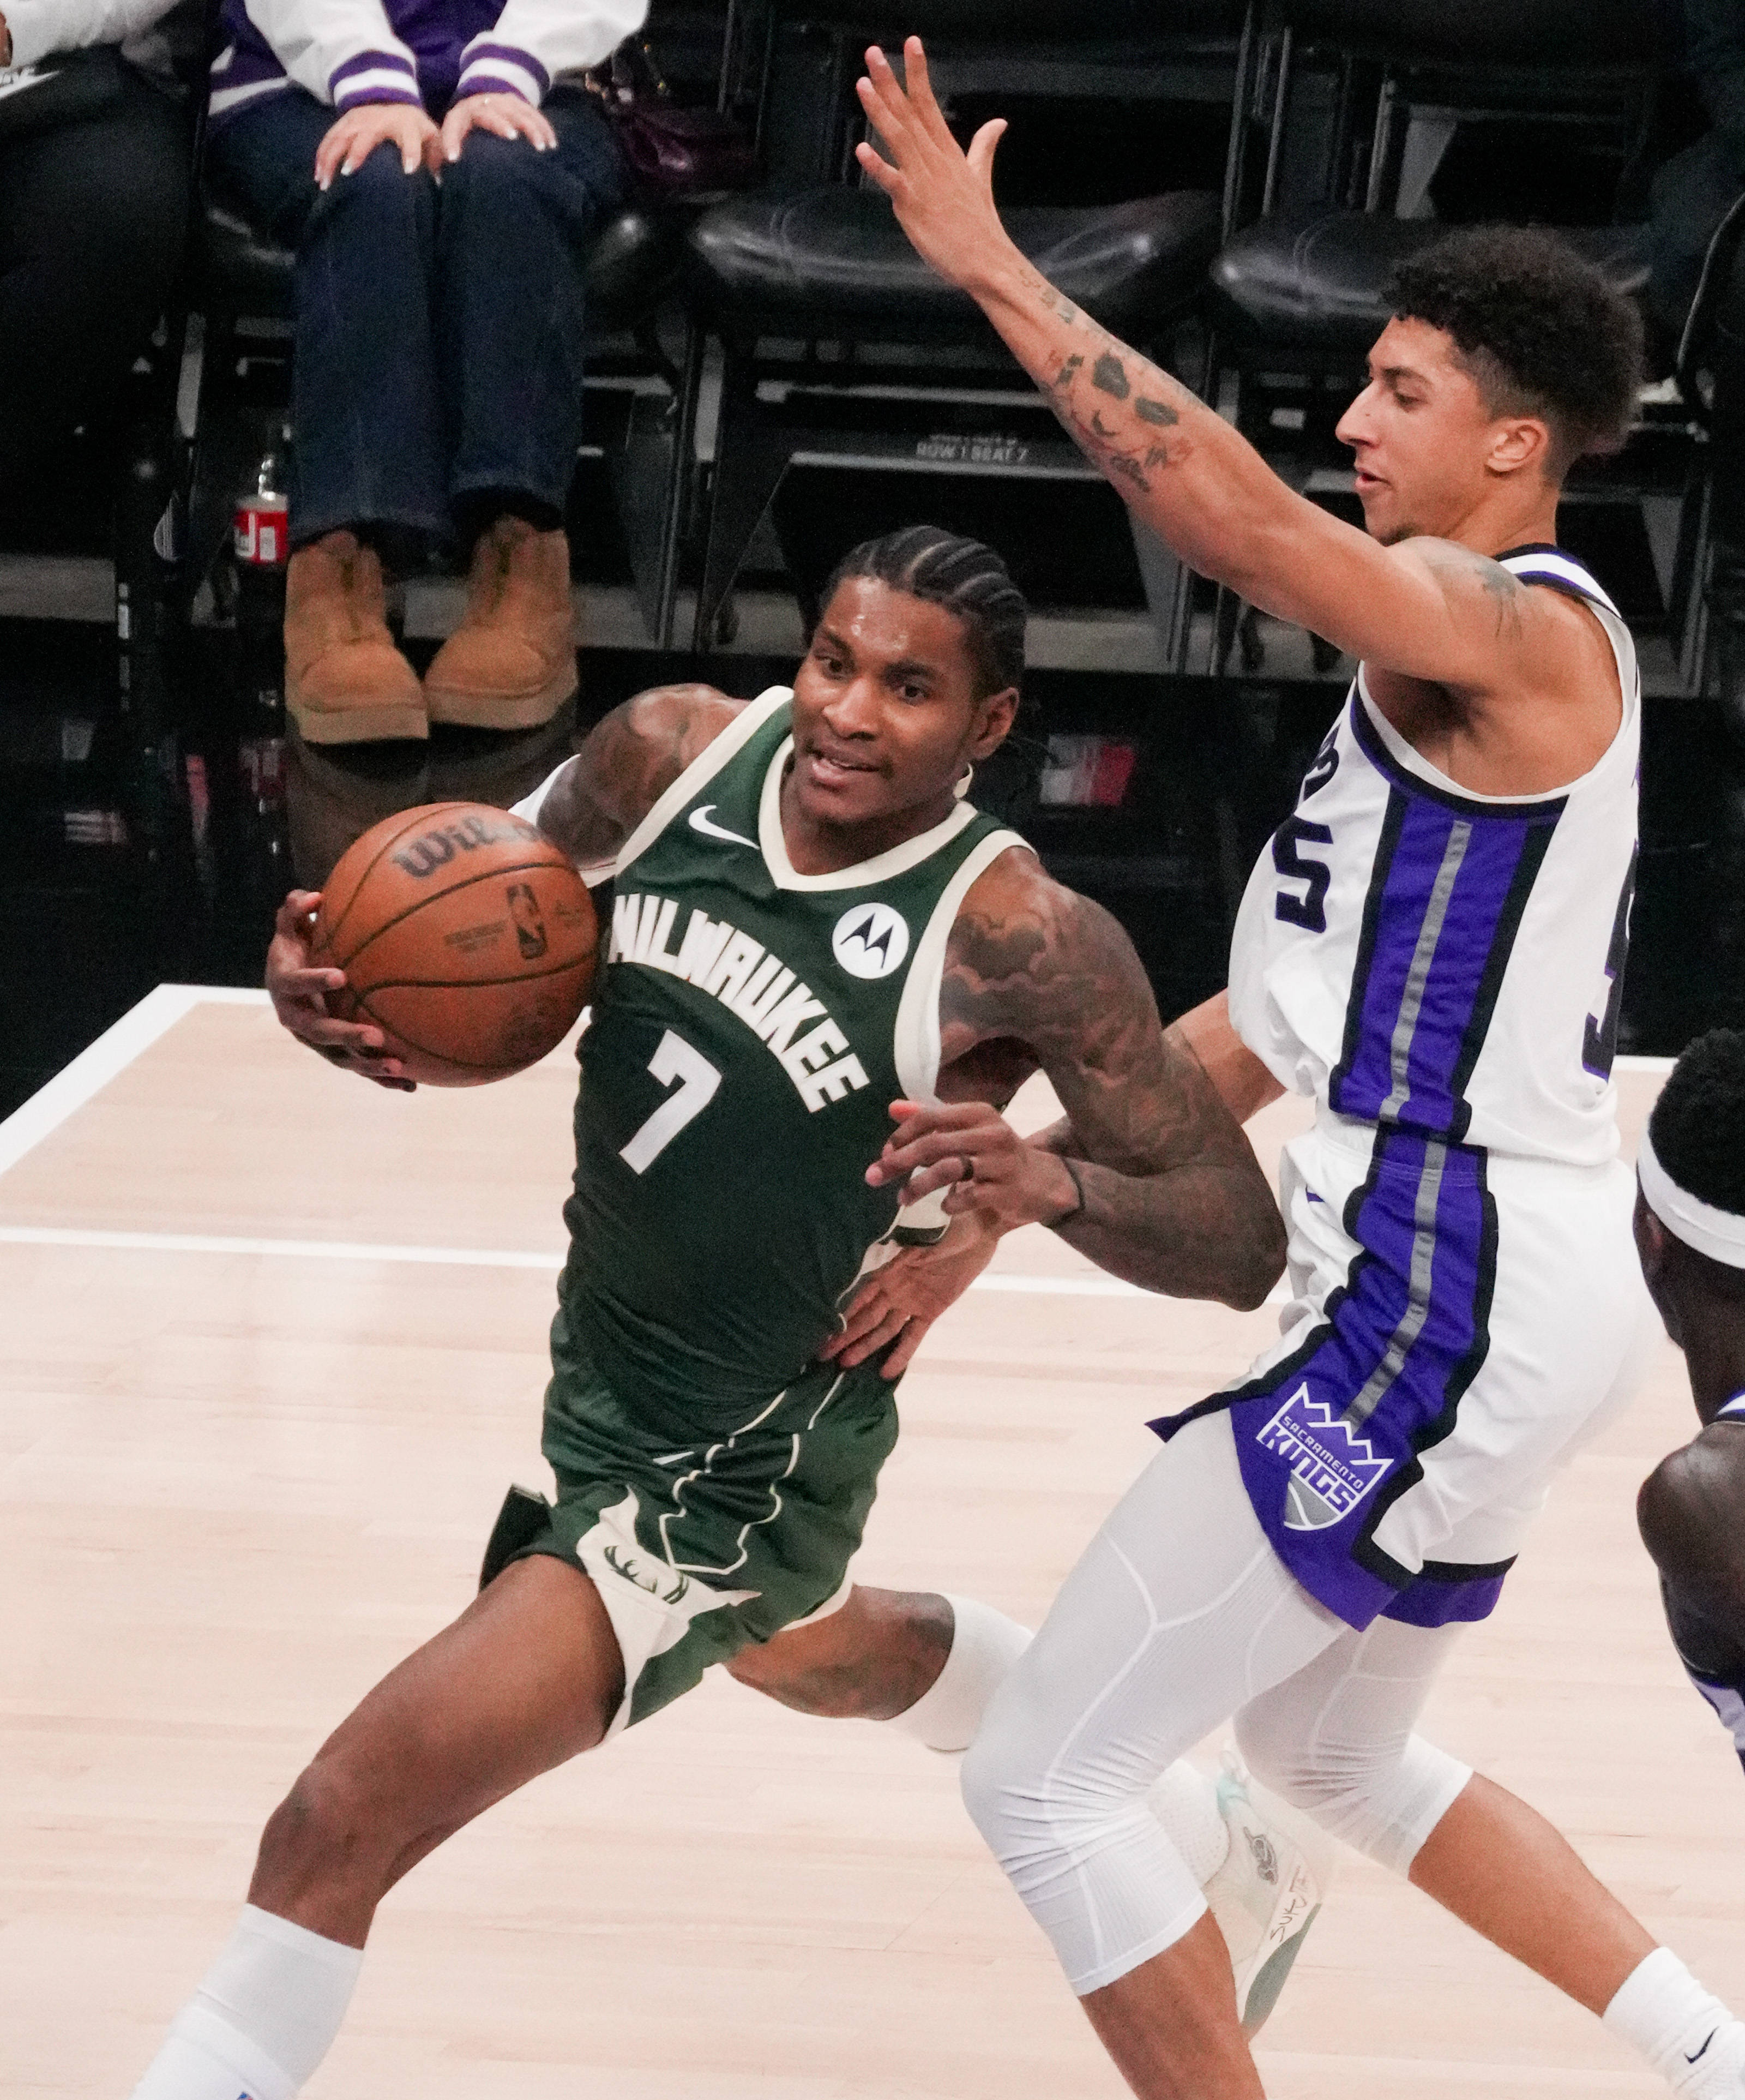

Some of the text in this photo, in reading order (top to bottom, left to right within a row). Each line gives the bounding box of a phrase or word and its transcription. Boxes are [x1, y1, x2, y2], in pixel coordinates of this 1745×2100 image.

[1272, 815, 1333, 933] 5
[607, 893, 870, 1113] MILWAUKEE
[619, 1029, 722, 1175] 7
[1257, 1423, 1357, 1513] KINGS
[1281, 1415, 1364, 1490] SACRAMENTO
